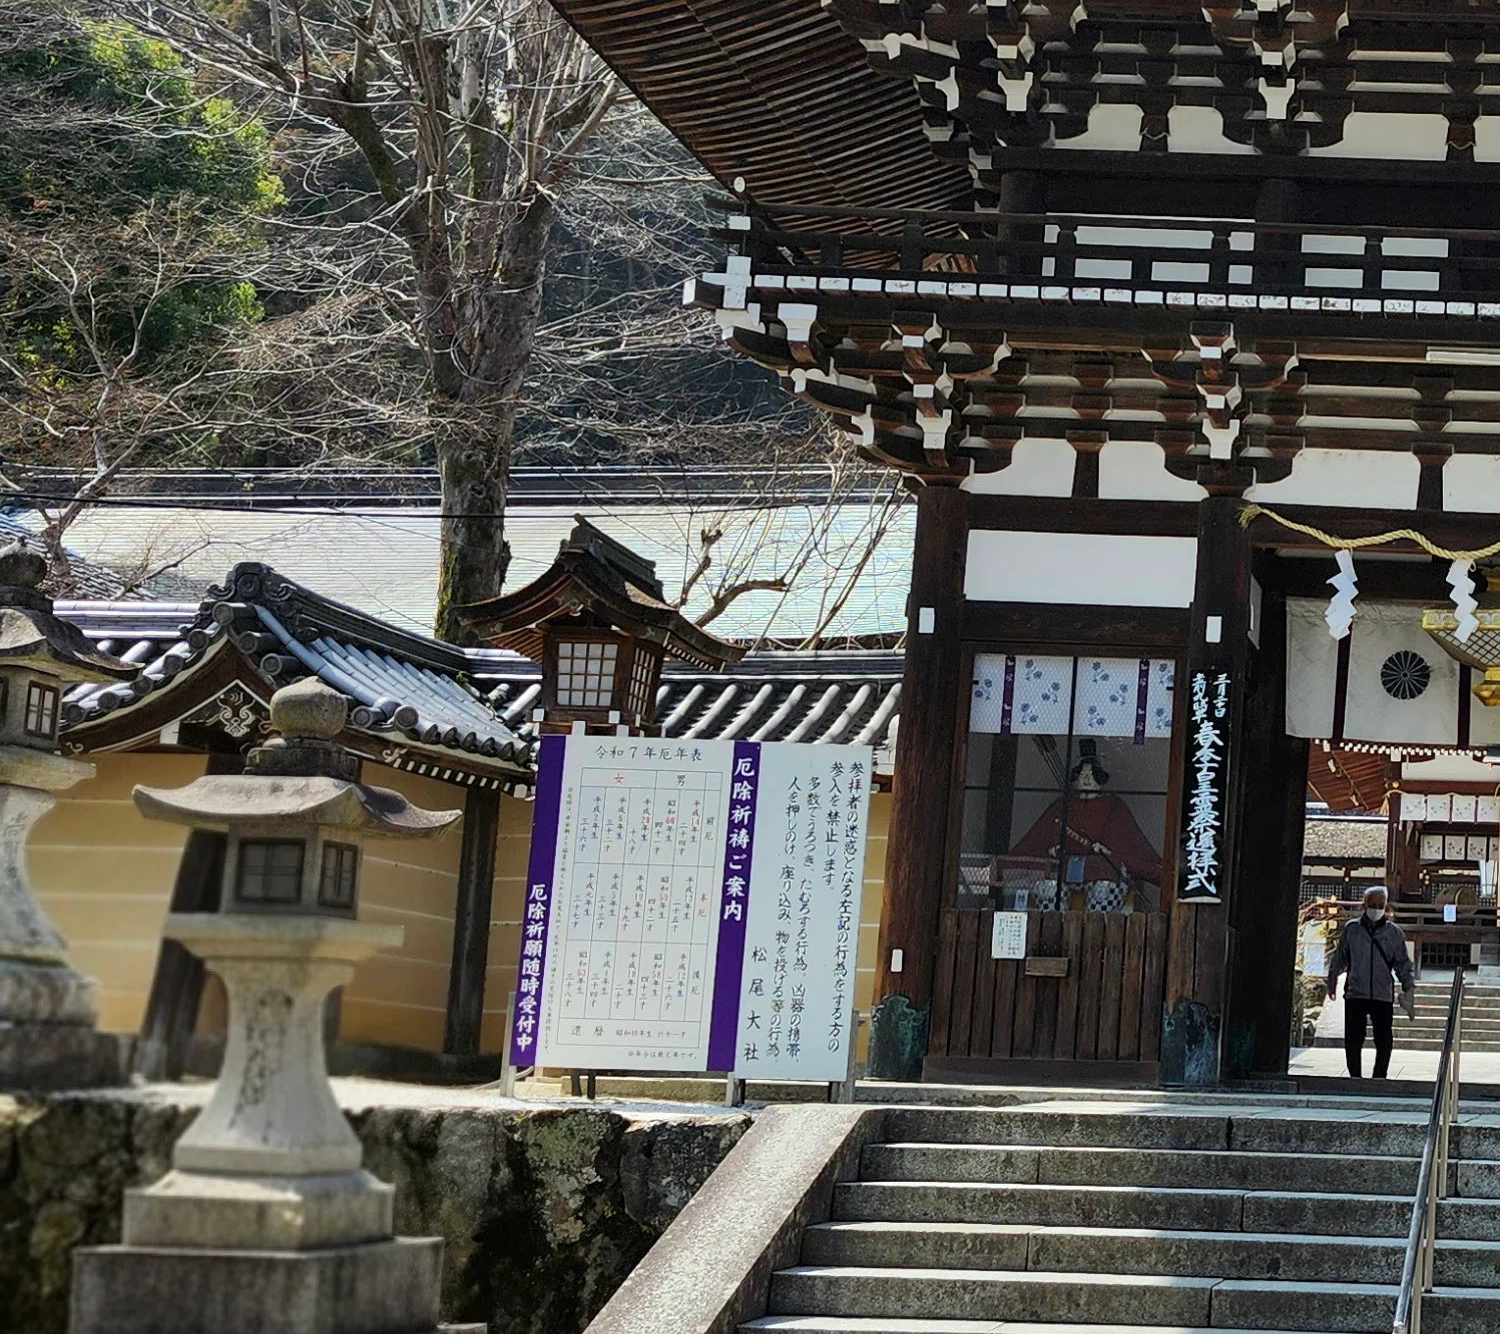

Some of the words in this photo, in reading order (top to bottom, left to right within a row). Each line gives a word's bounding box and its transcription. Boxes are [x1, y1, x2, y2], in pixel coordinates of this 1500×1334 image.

[595, 745, 703, 762] 令和7年厄年表
[614, 773, 624, 784] 女
[677, 774, 686, 786] 男
[822, 760, 845, 890] 参入を禁止します。
[516, 883, 548, 1053] 厄除祈願随時受付中
[743, 945, 767, 1062] 松尾大社
